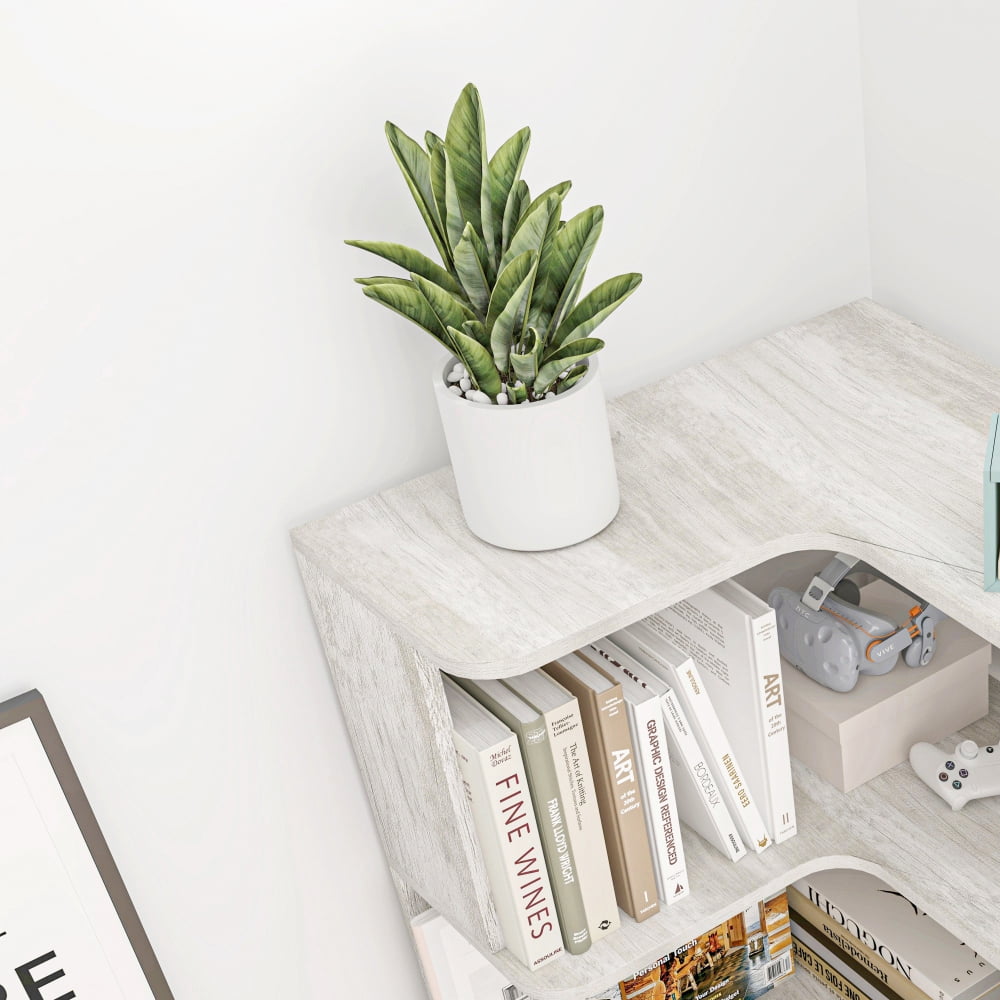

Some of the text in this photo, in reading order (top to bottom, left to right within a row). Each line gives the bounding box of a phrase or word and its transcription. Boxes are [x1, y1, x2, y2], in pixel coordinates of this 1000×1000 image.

[875, 643, 896, 658] VIVE
[763, 673, 782, 708] ART
[646, 719, 662, 767] GRAPHIC
[768, 726, 786, 738] Century
[569, 743, 578, 758] The
[576, 777, 588, 806] Knitting
[612, 748, 635, 786] ART
[653, 766, 668, 806] DESIGN
[693, 761, 721, 809] BORDEAUX
[721, 753, 751, 809] EERO SAARINEN
[620, 802, 641, 815] Century
[547, 797, 575, 885] FRANK LLOYD WRIGHT
[660, 804, 678, 866] REFERENCED
[495, 773, 553, 940] FINE WINES
[807, 885, 912, 982] NOGUCHI
[822, 923, 889, 985] Remodelista
[633, 939, 698, 980] Personal Touch
[810, 958, 824, 974] LE
[822, 968, 845, 991] FOIS
[695, 990, 709, 1000] Your
[708, 978, 731, 994] Design
